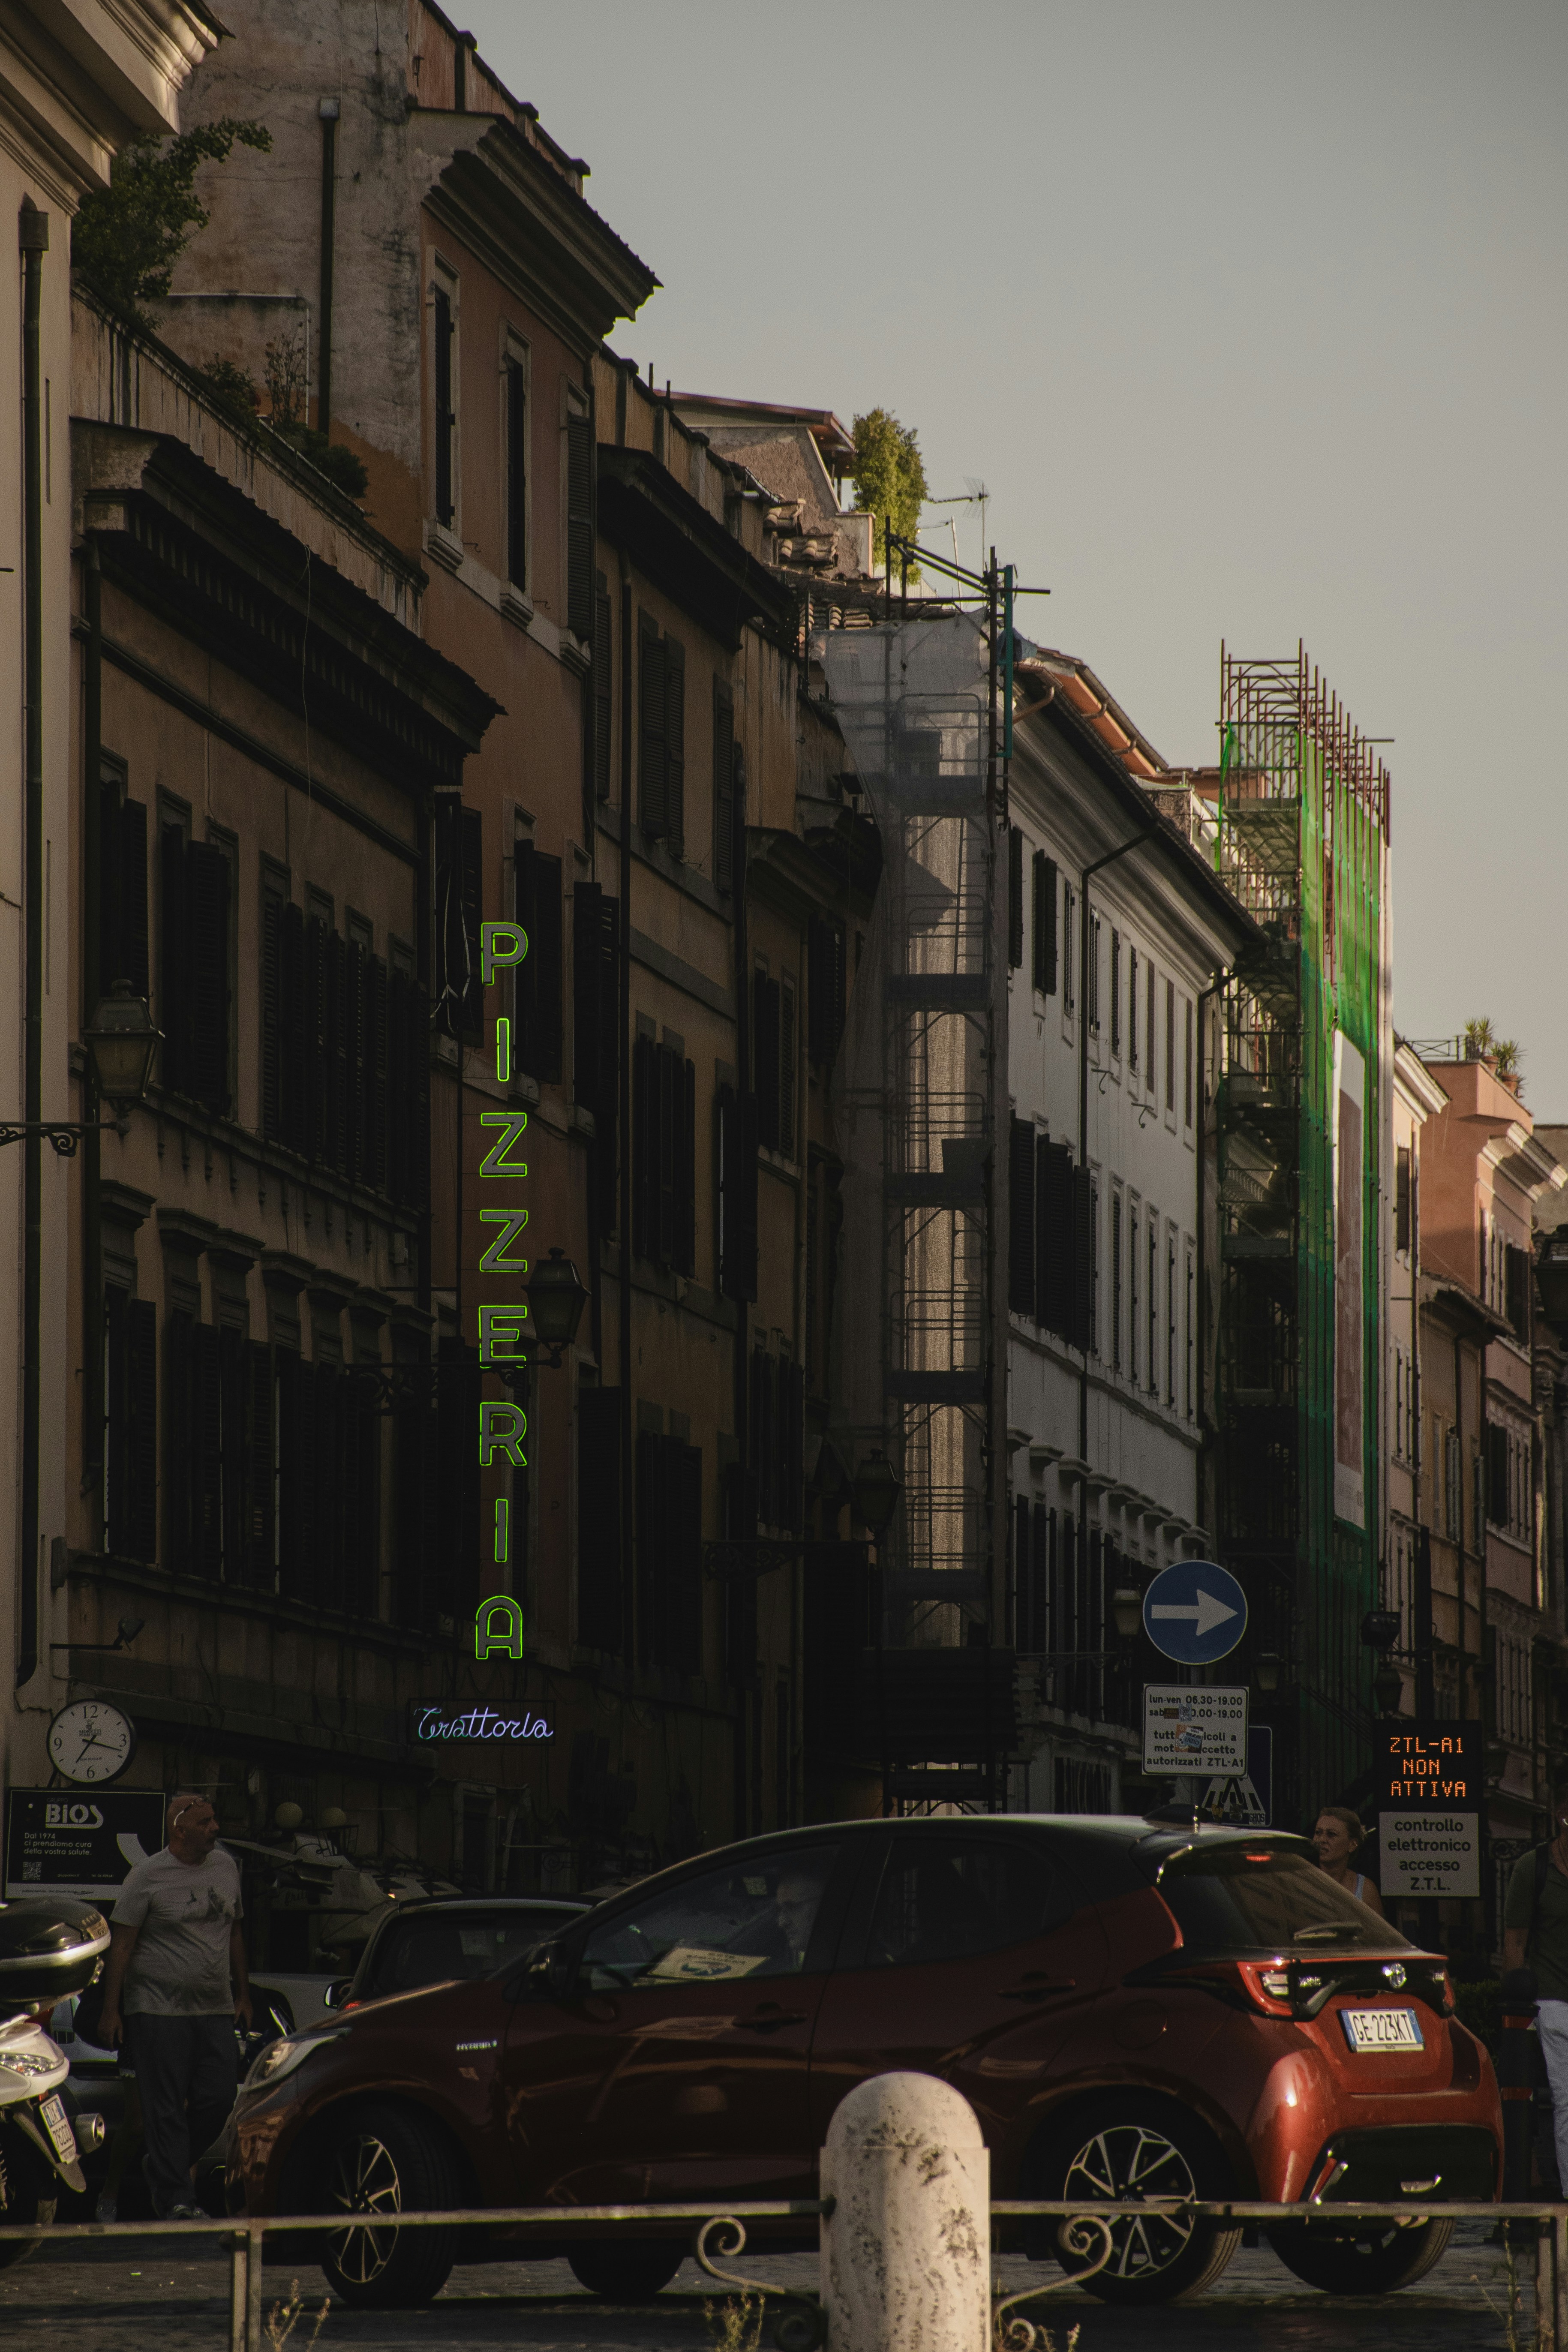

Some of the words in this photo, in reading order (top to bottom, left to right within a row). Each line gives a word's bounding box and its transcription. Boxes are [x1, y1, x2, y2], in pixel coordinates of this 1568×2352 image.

[476, 922, 529, 1660] PIZZERIA
[1149, 1694, 1181, 1704] lun-ven
[1186, 1695, 1242, 1706] 06.30-19.00
[83, 1705, 98, 1719] 12
[1149, 1708, 1164, 1716] sab
[1191, 1708, 1242, 1719] 0.00-19.00
[414, 1706, 554, 1739] Trattoria
[119, 1734, 127, 1747] 3
[1154, 1730, 1174, 1739] tutt
[1204, 1732, 1225, 1741] icoli
[54, 1737, 62, 1751] 9
[1154, 1744, 1174, 1753] mot
[1202, 1745, 1235, 1754] ccetto
[1390, 1737, 1463, 1754] ZTL-A1
[1147, 1756, 1202, 1766] autorizzati
[1207, 1758, 1244, 1767] ZTL-A1
[1403, 1759, 1440, 1775] NON
[87, 1765, 95, 1779] 6
[1391, 1781, 1466, 1797] ATTIVA
[1394, 1818, 1463, 1832] controllo
[1388, 1838, 1471, 1852] elettronico
[1399, 1860, 1460, 1871] accesso
[1410, 1878, 1450, 1890] Z.T.L.
[1353, 2015, 1373, 2042] GE
[1372, 2013, 1412, 2041] 223KT
